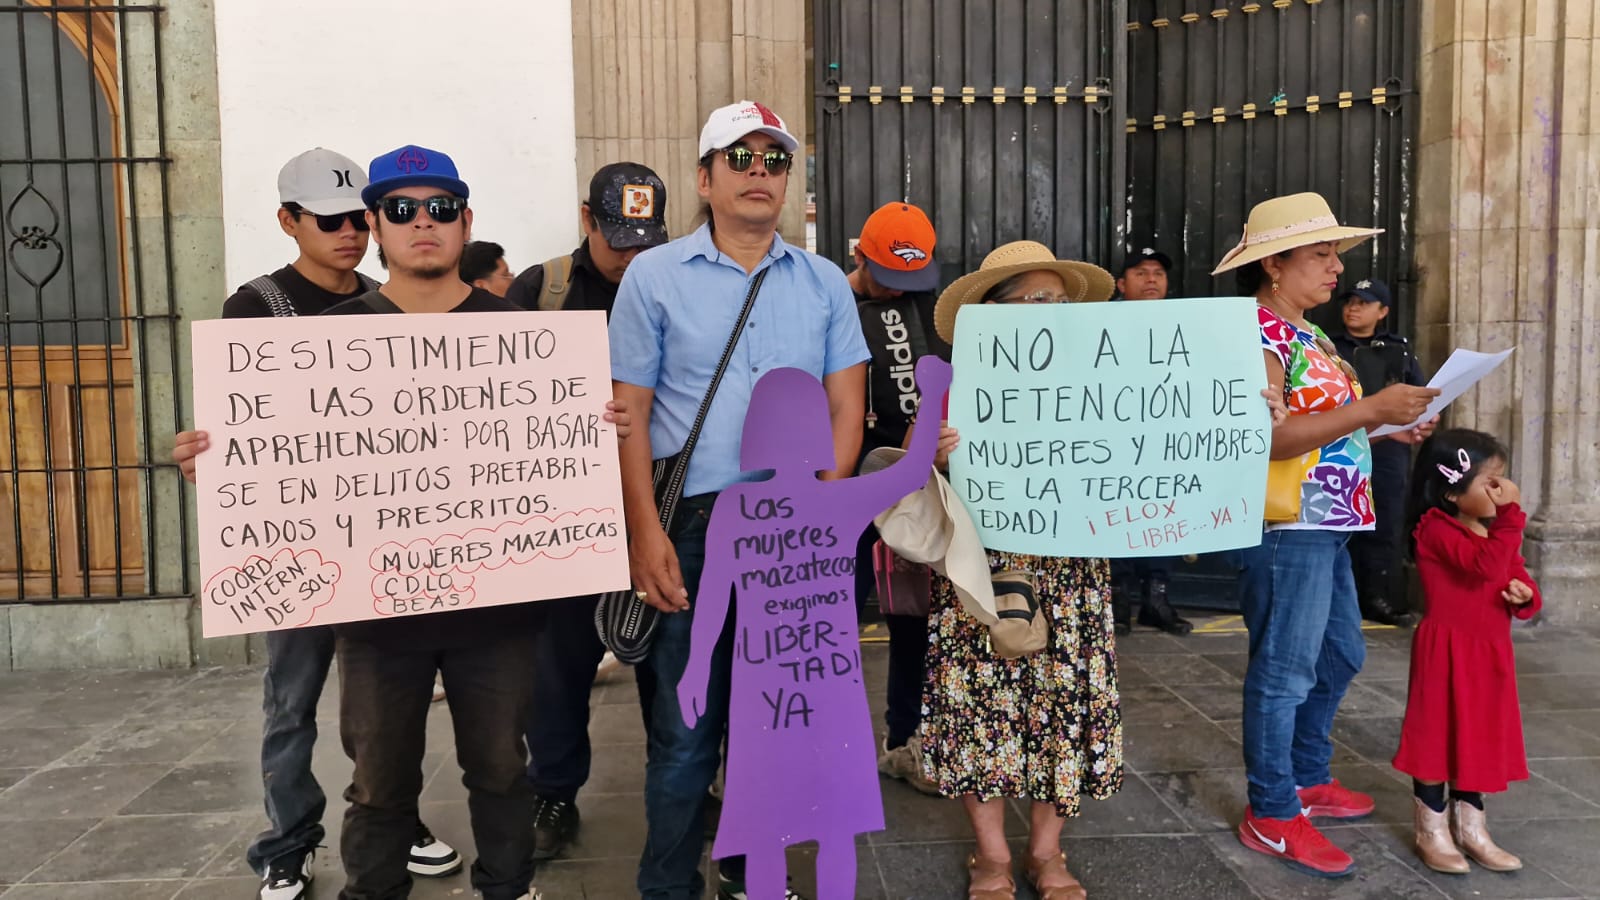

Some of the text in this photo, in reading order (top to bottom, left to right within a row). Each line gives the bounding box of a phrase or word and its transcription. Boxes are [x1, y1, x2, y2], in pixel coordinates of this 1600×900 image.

[227, 328, 557, 373] DESISTIMIENTO
[1094, 327, 1120, 368] A
[1149, 323, 1191, 367] LA
[225, 393, 276, 426] DE
[309, 386, 374, 419] LAS
[551, 376, 588, 405] DE
[975, 371, 1247, 423] DETENCIÓN DE
[463, 418, 511, 452] POR
[526, 412, 608, 450] BASAR-
[968, 438, 1113, 468] MUJERES
[1164, 428, 1266, 462] HOMBRES
[217, 456, 601, 508] SE EN DELITOS PREFABRI-
[966, 474, 1203, 504] DE LA TERCERA
[220, 517, 317, 549] CADOS
[376, 494, 558, 531] PRESCRITOS.
[740, 494, 794, 520] Las
[980, 508, 1058, 538] EDAD!
[382, 521, 618, 573] MUJERES MAZATECAS
[733, 526, 838, 561] mujeres
[210, 557, 278, 607] COORD.
[230, 555, 308, 623] INTERN.
[741, 552, 857, 591] mazatecas
[265, 600, 296, 626] DE
[393, 592, 461, 614] BEAS
[764, 589, 849, 621] exigimos
[779, 650, 859, 683] TAD!
[761, 688, 814, 730] YA
